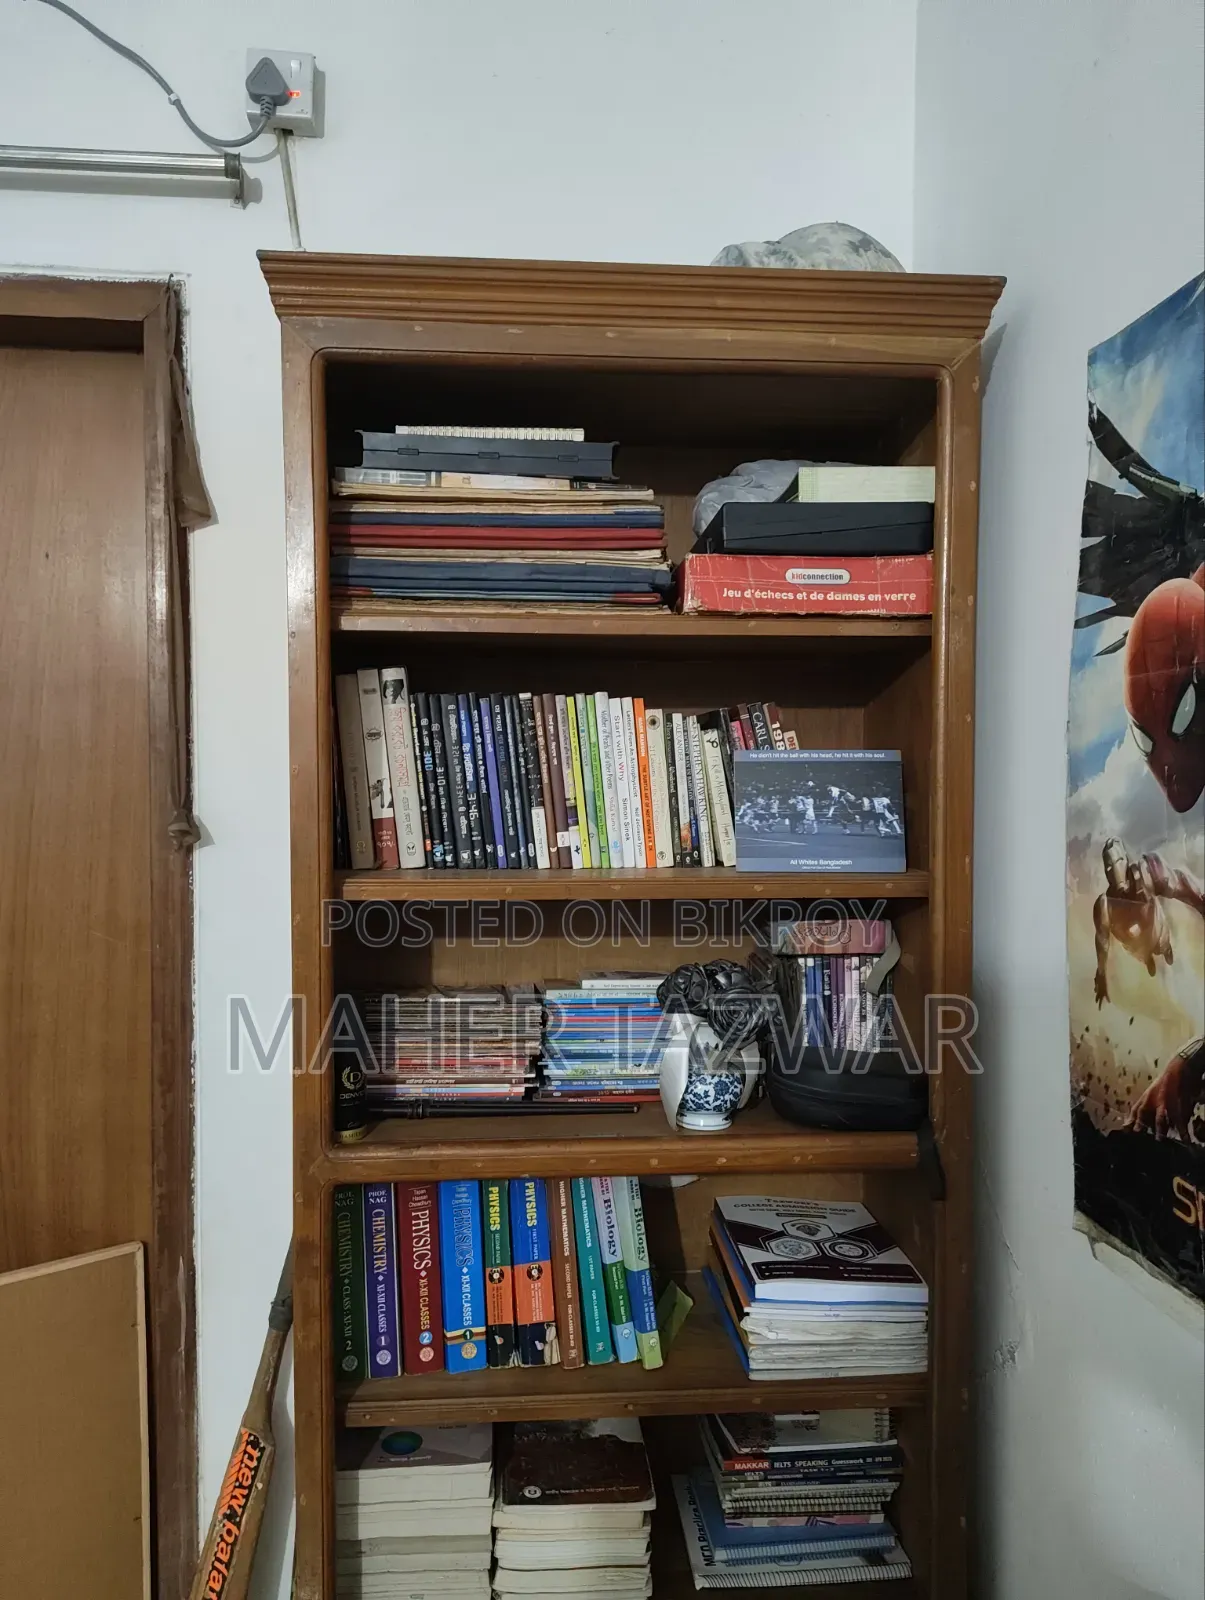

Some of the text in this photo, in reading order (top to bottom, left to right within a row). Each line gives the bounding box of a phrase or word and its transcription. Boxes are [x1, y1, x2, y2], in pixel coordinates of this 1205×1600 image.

[723, 587, 741, 598] Jeu
[744, 588, 794, 600] d'échecs
[810, 590, 824, 601] de
[827, 591, 865, 602] dames
[868, 592, 881, 602] en
[884, 592, 917, 602] verre
[791, 572, 844, 581] kidconnection
[630, 748, 635, 756] An
[676, 723, 684, 762] ALEXANDER
[752, 712, 768, 744] CARL
[692, 734, 702, 775] STEPHEN
[697, 778, 708, 822] HAWKING
[467, 792, 478, 820] 3:46
[488, 1186, 501, 1231] PHYSICS
[524, 1182, 538, 1227] PHYSICS
[578, 1178, 592, 1248] IGHER MATHEMATICS
[602, 1198, 618, 1258] Biology
[336, 1212, 352, 1278] CHEMISTRY
[372, 1208, 388, 1274] CHEMISTRY
[412, 1210, 432, 1270] PHYSICS
[454, 1208, 474, 1268] PHYSICS
[560, 1208, 570, 1256] MATHEMATICS
[632, 1206, 648, 1264] Biology
[344, 1315, 352, 1337] XI-XII
[377, 1284, 386, 1346] XI-XII CLASSES 1
[418, 1278, 430, 1344] XI-XII CLASSES 2
[461, 1275, 472, 1340] XI-XII CLASSES 1
[345, 1340, 352, 1351] 2
[230, 1444, 262, 1518] new
[734, 1461, 770, 1470] MAKKAR
